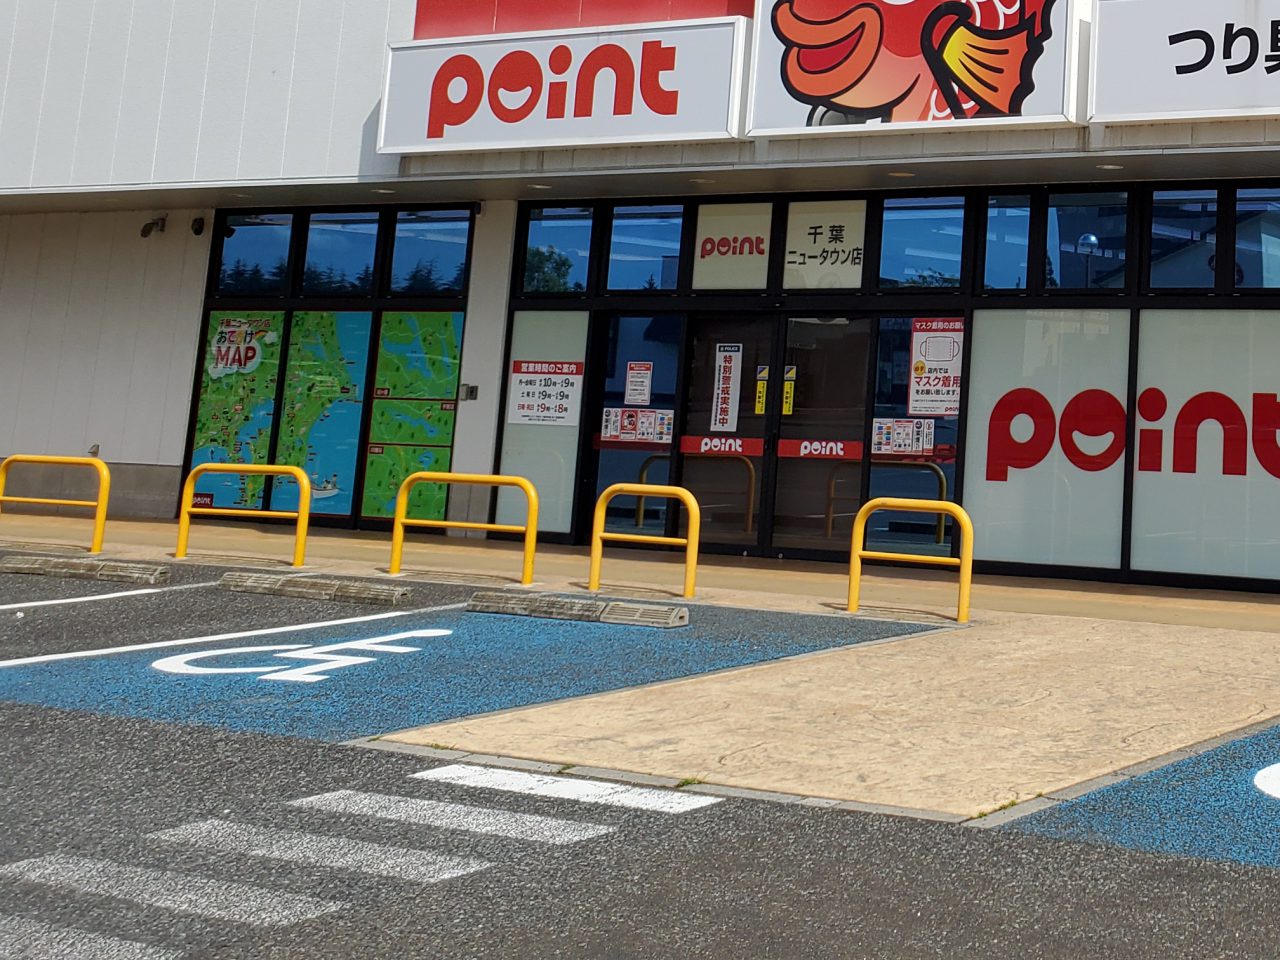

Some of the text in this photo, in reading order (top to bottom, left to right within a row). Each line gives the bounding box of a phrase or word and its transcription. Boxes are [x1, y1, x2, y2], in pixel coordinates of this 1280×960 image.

[426, 40, 679, 139] point
[807, 224, 846, 245] 千葉
[700, 235, 766, 259] point
[787, 247, 863, 267] ニュータウン店
[213, 345, 257, 368] MAP
[521, 362, 577, 374] 営業時間のご案内
[913, 375, 961, 388] マスク着用
[944, 405, 960, 413] poin
[700, 437, 743, 453] point
[800, 440, 844, 456] point
